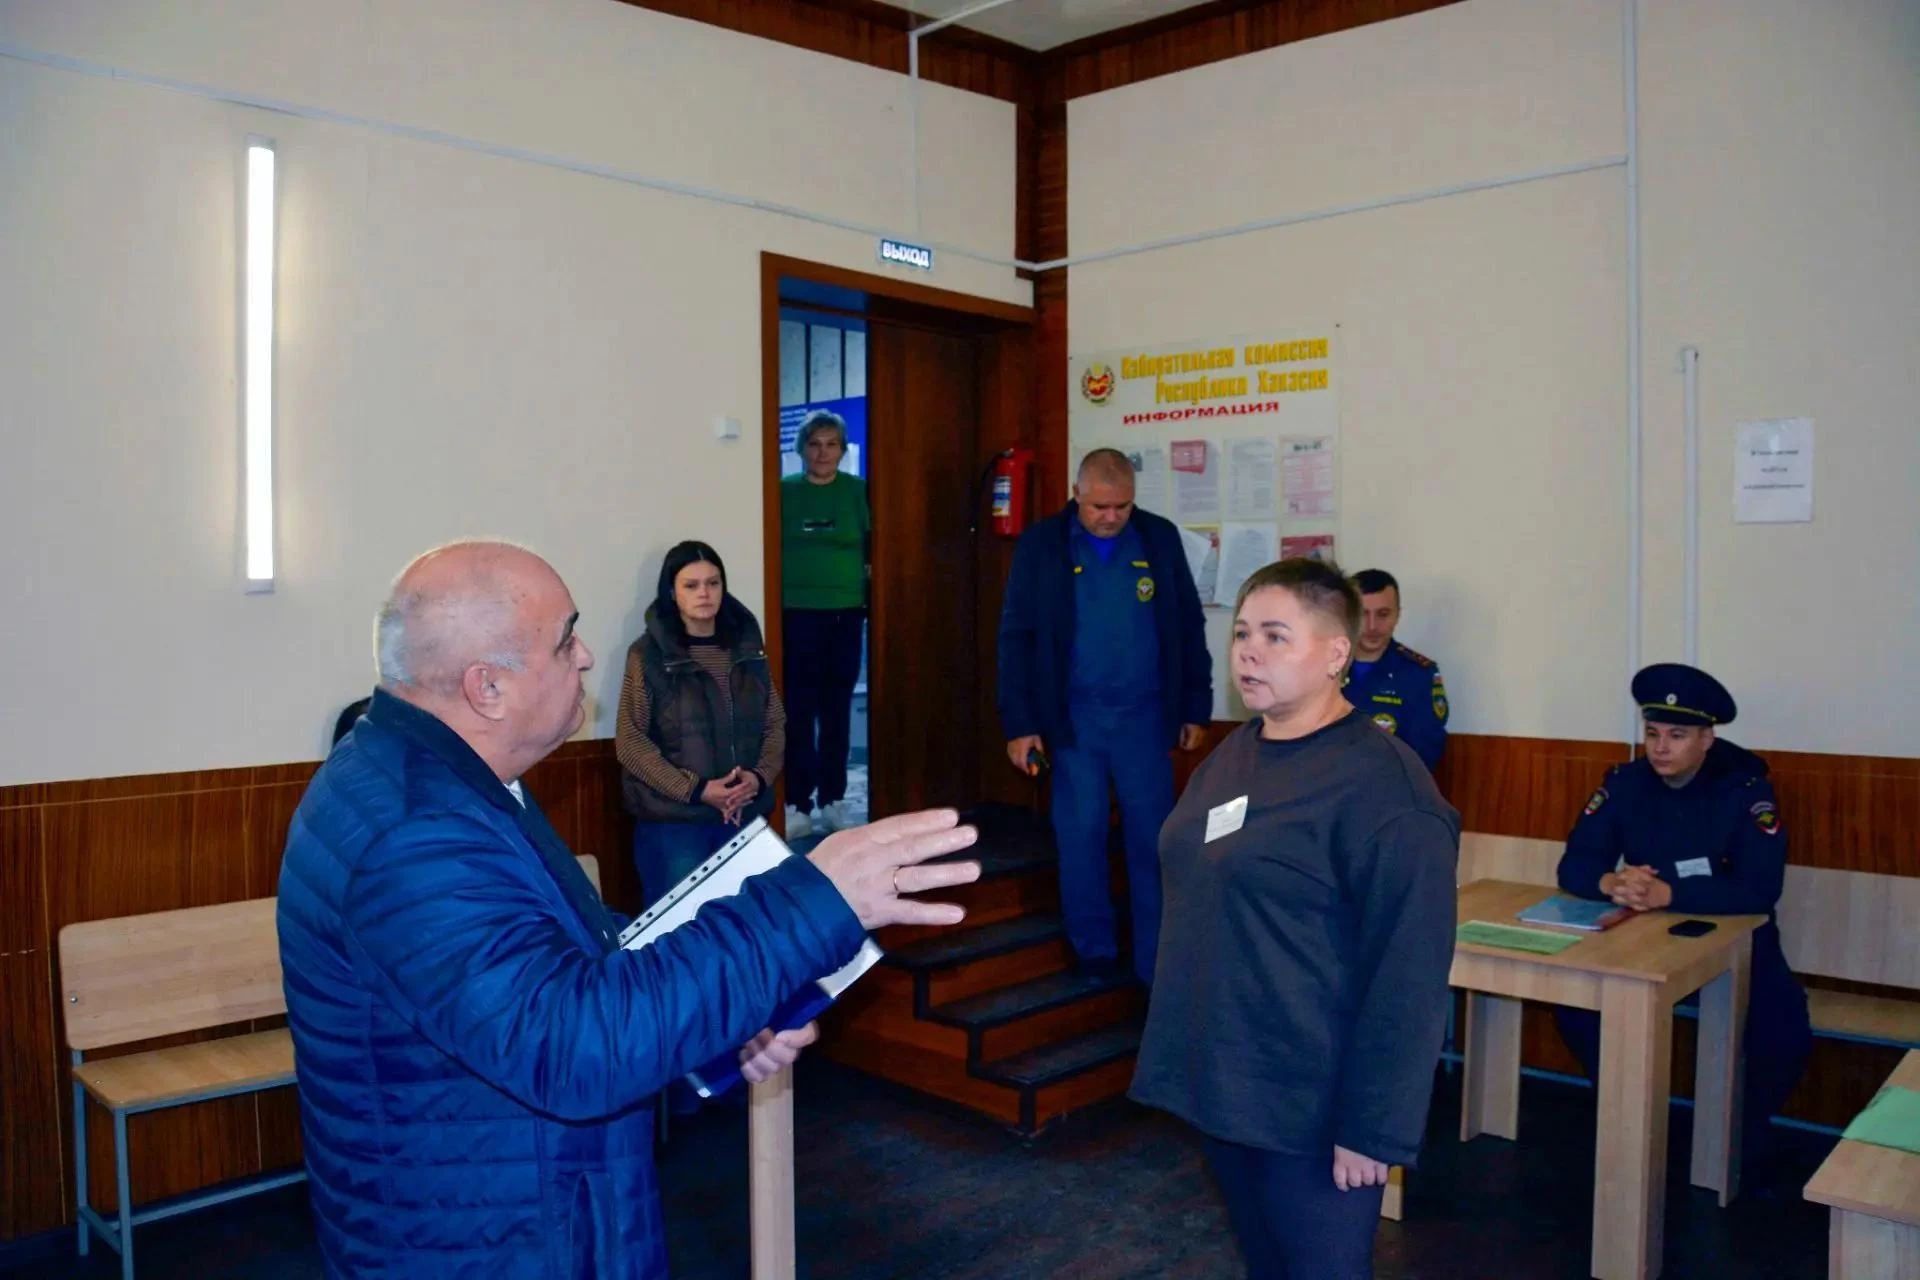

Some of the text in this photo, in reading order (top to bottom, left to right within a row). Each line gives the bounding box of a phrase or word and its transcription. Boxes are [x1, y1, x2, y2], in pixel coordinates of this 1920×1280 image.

[883, 241, 929, 267] ВЫХОД
[1256, 369, 1328, 395] Хакасия
[1123, 401, 1280, 425] ИНФОРМАЦИЯ
